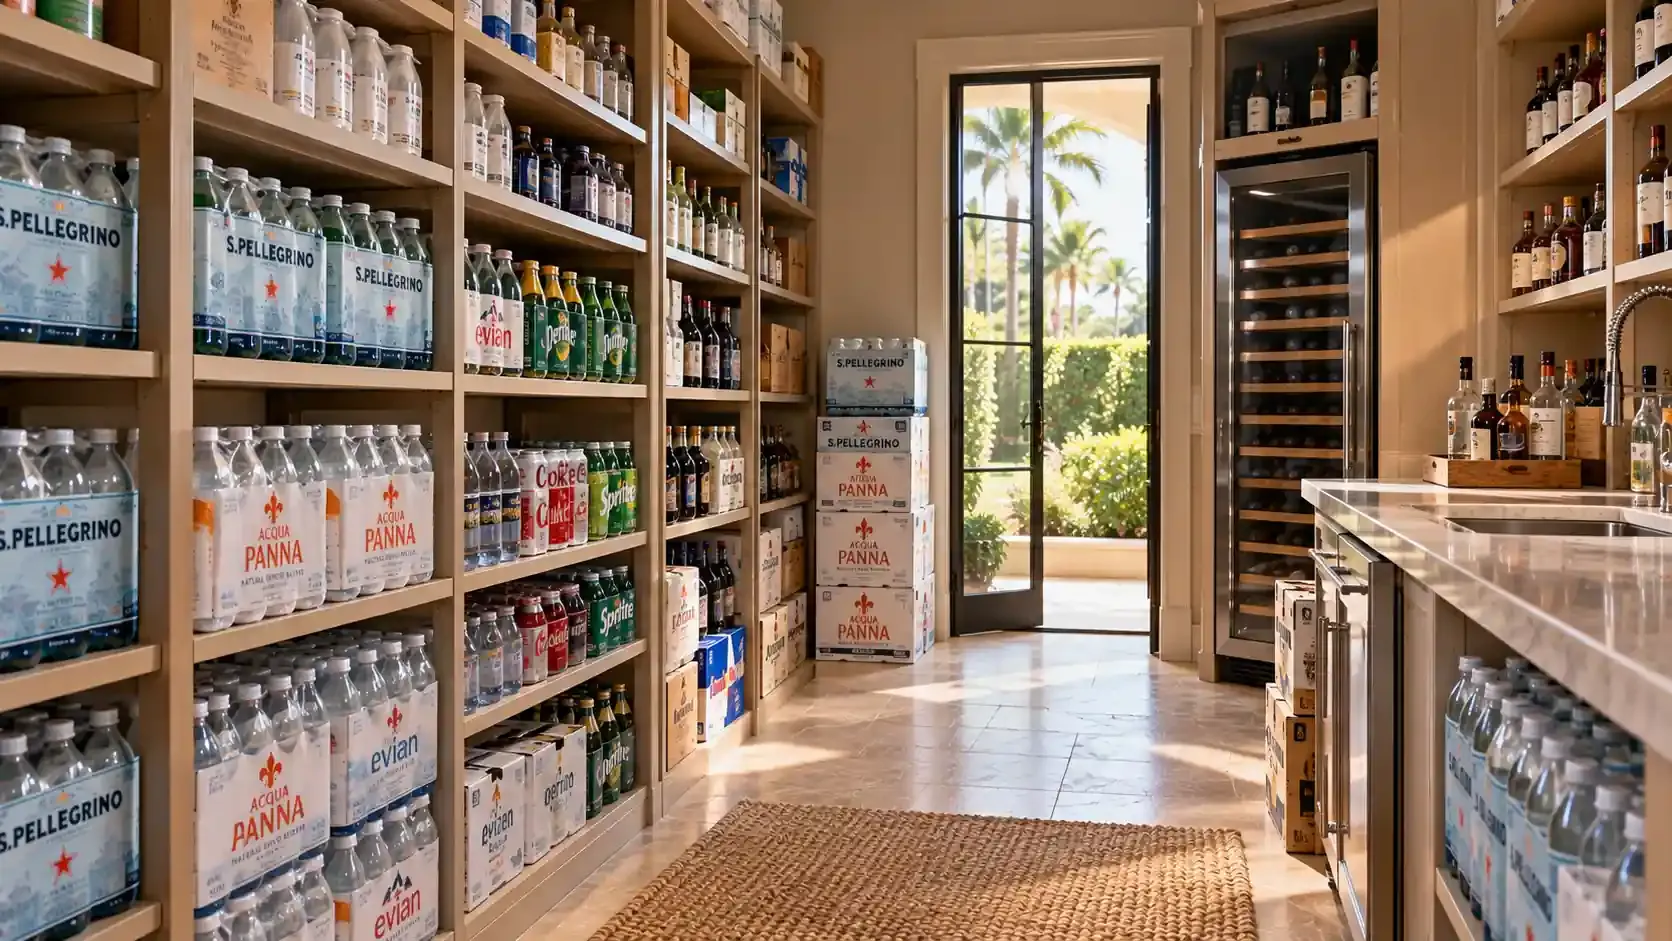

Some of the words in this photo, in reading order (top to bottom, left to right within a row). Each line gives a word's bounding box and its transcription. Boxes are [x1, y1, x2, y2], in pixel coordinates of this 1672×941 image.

[226, 235, 314, 268] S.PELLEGRINO
[355, 266, 423, 292] S.PELLEGRINO
[475, 323, 512, 349] evian
[836, 358, 904, 368] S.PELLEGRINO
[827, 438, 900, 448] S.PELLEGRINO
[838, 483, 889, 497] PANNA
[377, 510, 405, 525] ACQUA
[258, 524, 290, 541] ACQUA
[365, 522, 416, 552] PANNA
[849, 541, 878, 549] ACQUA
[244, 539, 304, 572] PANNA
[838, 550, 890, 566] PANNA
[838, 624, 890, 640] PANNA
[849, 615, 879, 624] ACQUA
[371, 734, 418, 774] evian
[250, 784, 289, 813] ACQUA
[0, 790, 123, 854] S.PELLEGRINO
[231, 795, 305, 852] PANNA
[374, 889, 421, 939] evian
